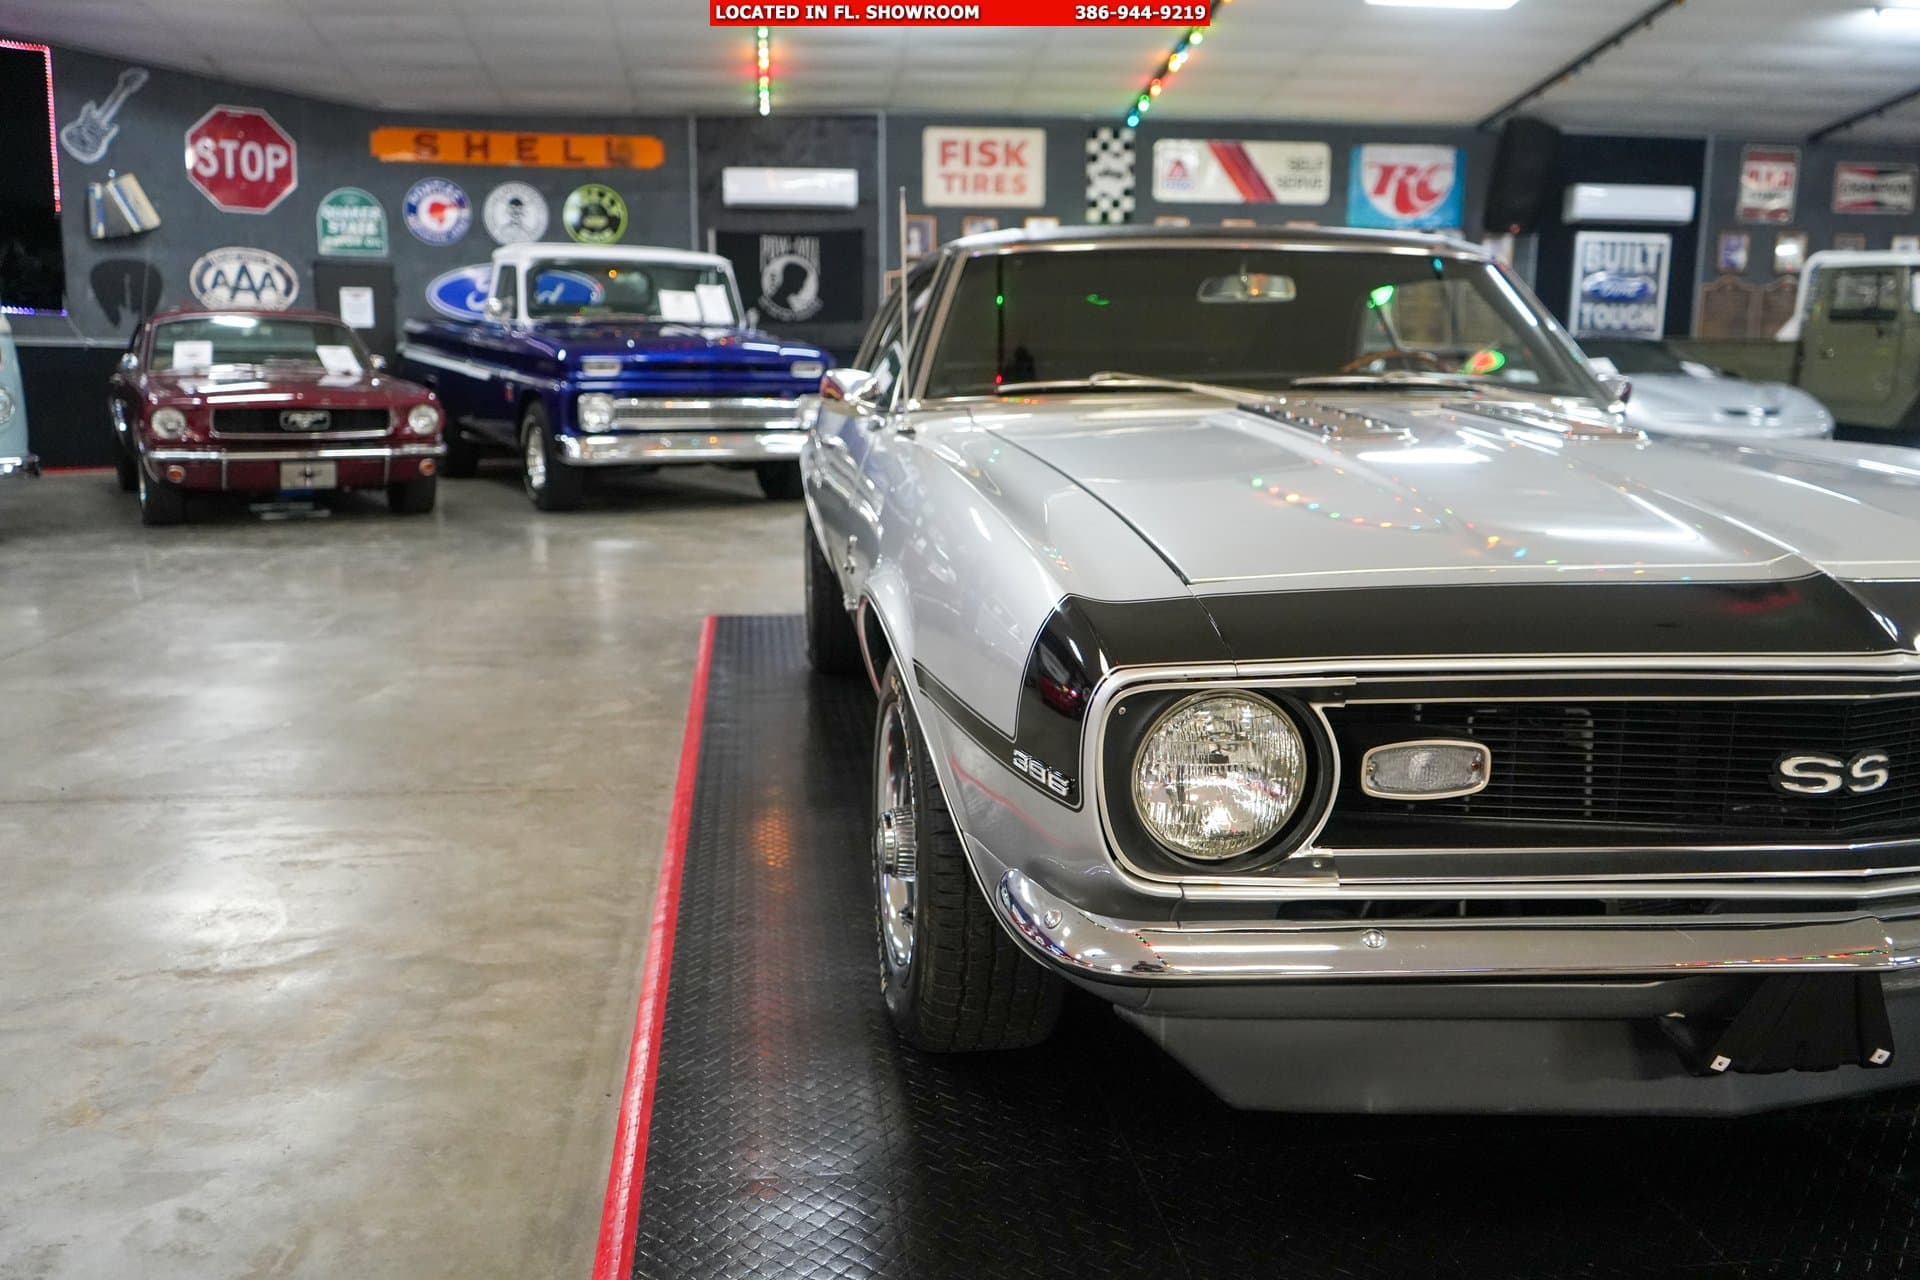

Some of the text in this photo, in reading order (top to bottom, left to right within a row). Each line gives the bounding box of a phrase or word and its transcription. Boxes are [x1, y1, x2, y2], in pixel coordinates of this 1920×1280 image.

[195, 136, 289, 183] STOP
[413, 132, 622, 167] SHELL
[938, 139, 1030, 168] FISK
[1286, 159, 1324, 172] SELF
[940, 173, 1028, 195] TIRES
[1368, 161, 1451, 215] RC
[327, 220, 378, 235] STATE
[1584, 241, 1664, 274] BUILT
[211, 263, 278, 300] AAA
[1580, 302, 1656, 332] TOUGH
[1779, 754, 1890, 794] SS
